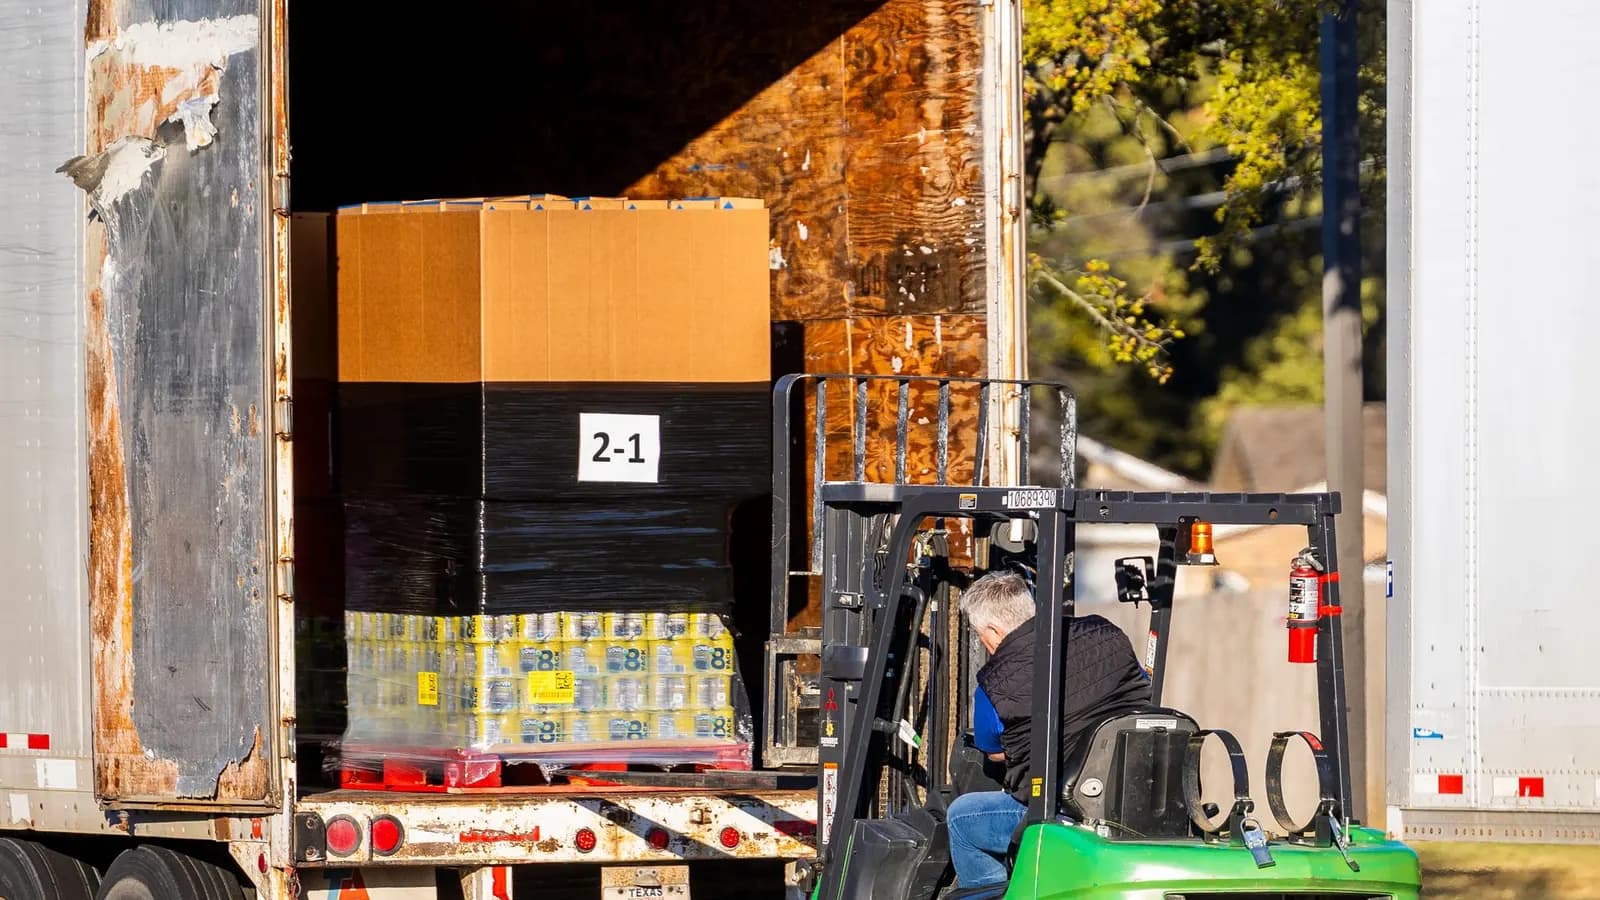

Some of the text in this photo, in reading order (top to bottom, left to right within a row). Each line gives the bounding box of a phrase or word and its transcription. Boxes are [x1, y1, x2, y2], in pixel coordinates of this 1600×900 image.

[592, 431, 645, 463] 2-1
[537, 650, 553, 671] 8
[624, 648, 640, 671] 8
[711, 647, 725, 670] 8
[629, 887, 663, 897] TEXAS
